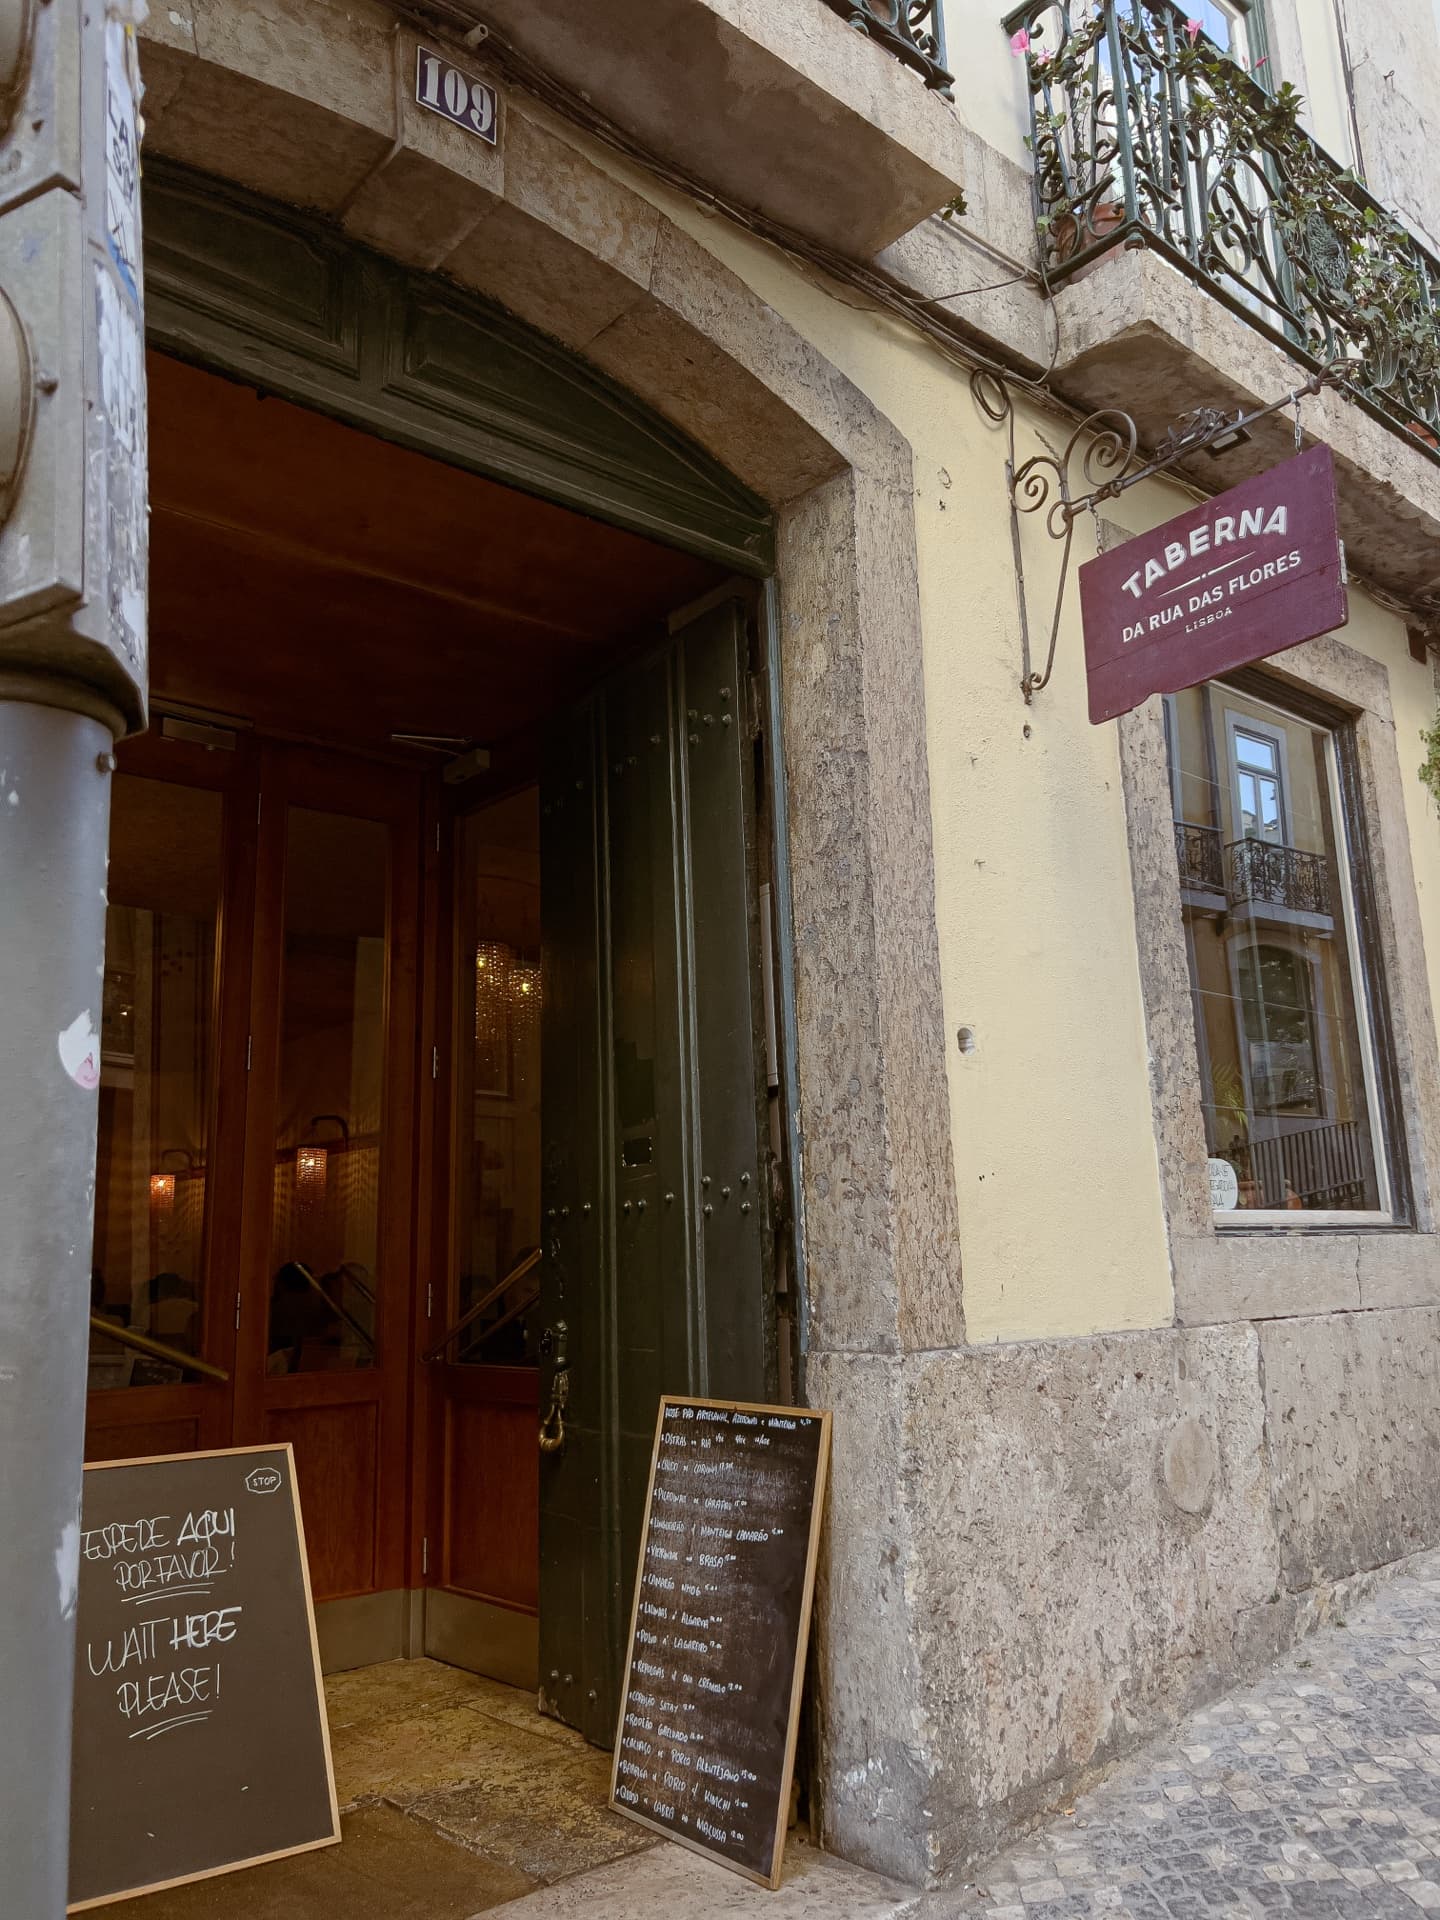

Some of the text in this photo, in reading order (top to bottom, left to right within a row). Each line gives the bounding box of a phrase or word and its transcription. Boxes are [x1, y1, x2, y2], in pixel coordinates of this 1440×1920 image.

[422, 57, 492, 132] 109
[1121, 505, 1288, 599] TABERNA
[1122, 550, 1302, 643] DA RUA DAS FLORES
[1185, 607, 1233, 633] LISBOA
[665, 1432, 687, 1447] OSTRAS
[253, 1476, 277, 1486] STOP
[80, 1508, 235, 1559] ESPERE AQUI
[736, 1529, 769, 1541] CAMARÃO
[699, 1553, 724, 1568] BRASA
[648, 1573, 675, 1590] CAMARÃO
[88, 1606, 242, 1675] WAIT HERE
[660, 1700, 679, 1712] SATAY
[671, 1748, 691, 1766] PORCO
[696, 1756, 740, 1782] ALENTEJANO
[664, 1771, 686, 1792] PORCO
[653, 1800, 675, 1819] CABRA
